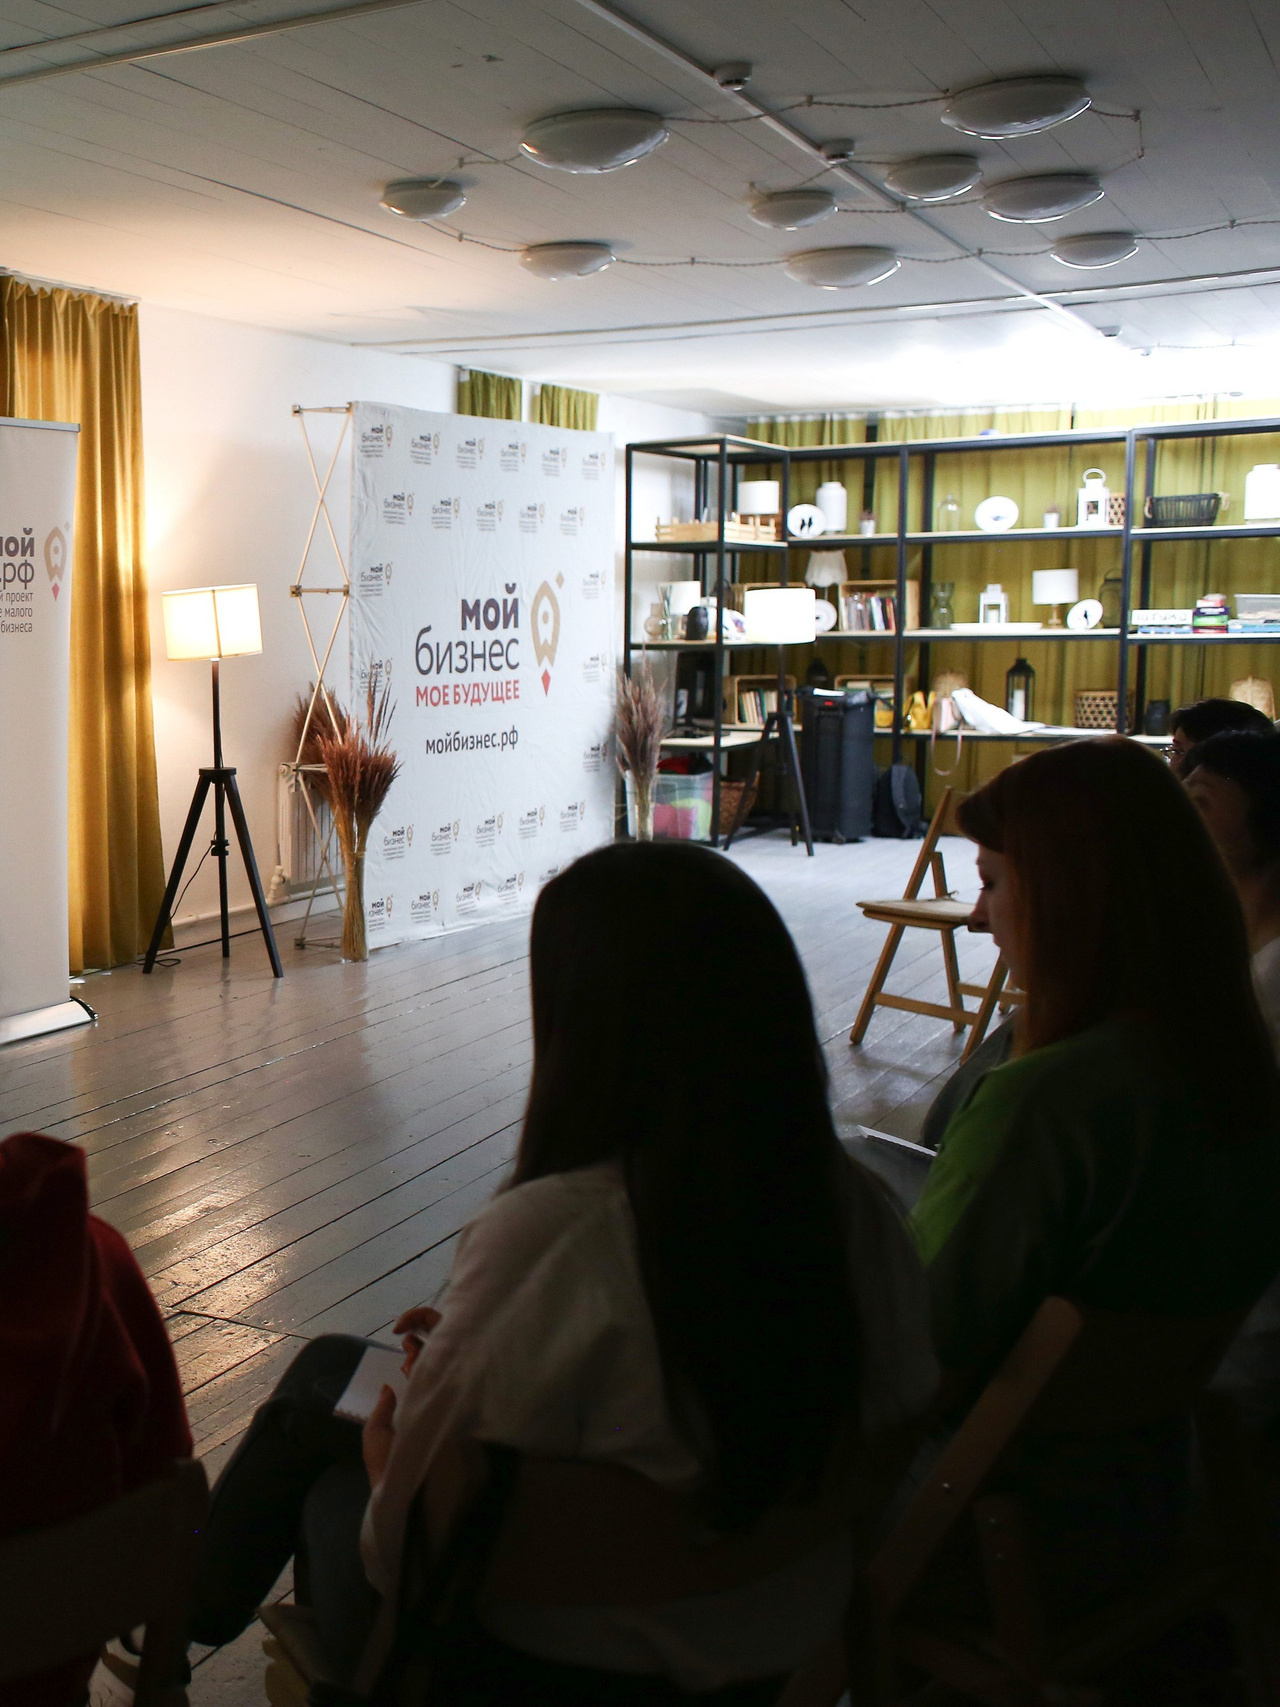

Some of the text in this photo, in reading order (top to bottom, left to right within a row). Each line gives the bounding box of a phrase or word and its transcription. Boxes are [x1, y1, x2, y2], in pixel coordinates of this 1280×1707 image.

[6, 592, 33, 605] проект
[5, 607, 33, 618] малого
[1, 621, 33, 633] бизнеса
[415, 625, 520, 676] бизнес
[416, 679, 520, 707] МОЕ БУДУЩЕЕ
[426, 725, 519, 754] мойбизнес.рф
